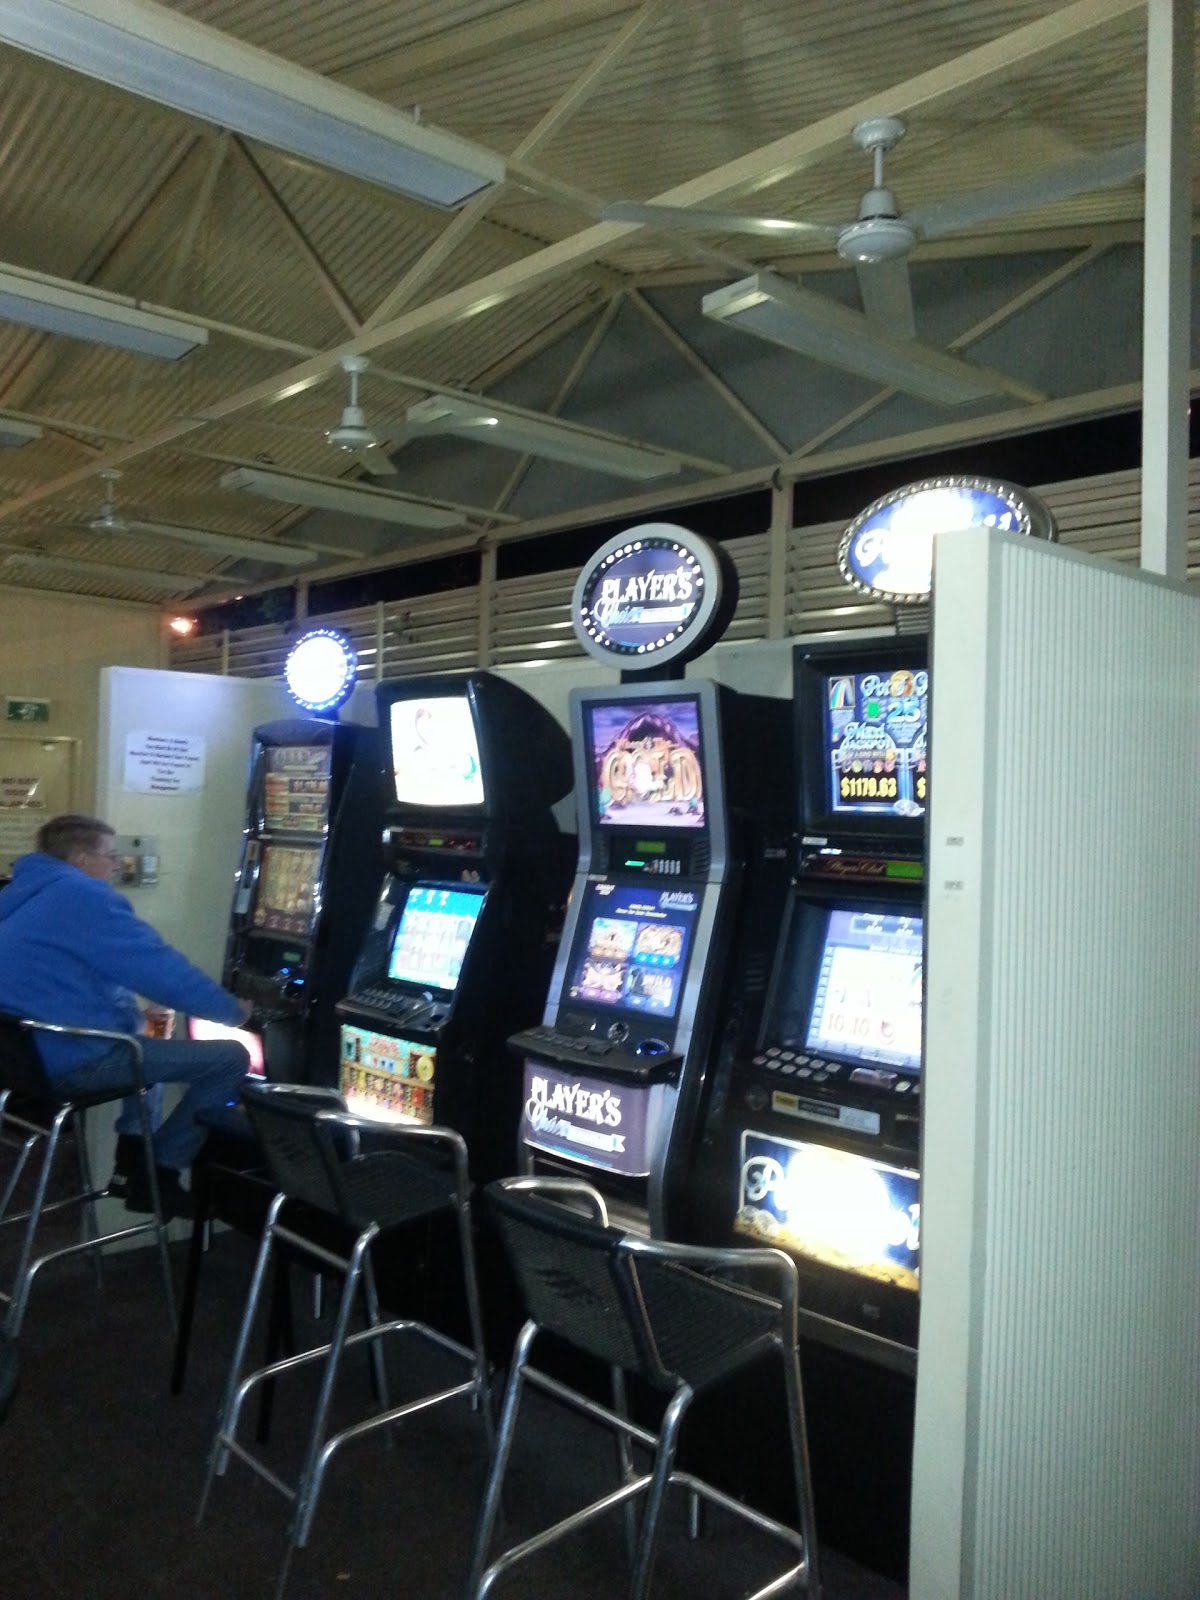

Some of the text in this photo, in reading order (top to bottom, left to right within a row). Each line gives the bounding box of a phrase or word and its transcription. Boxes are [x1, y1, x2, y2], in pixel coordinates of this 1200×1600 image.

[601, 566, 693, 604] PLAYER'S
[885, 700, 921, 724] 25
[531, 1076, 622, 1128] PLAYER'S
